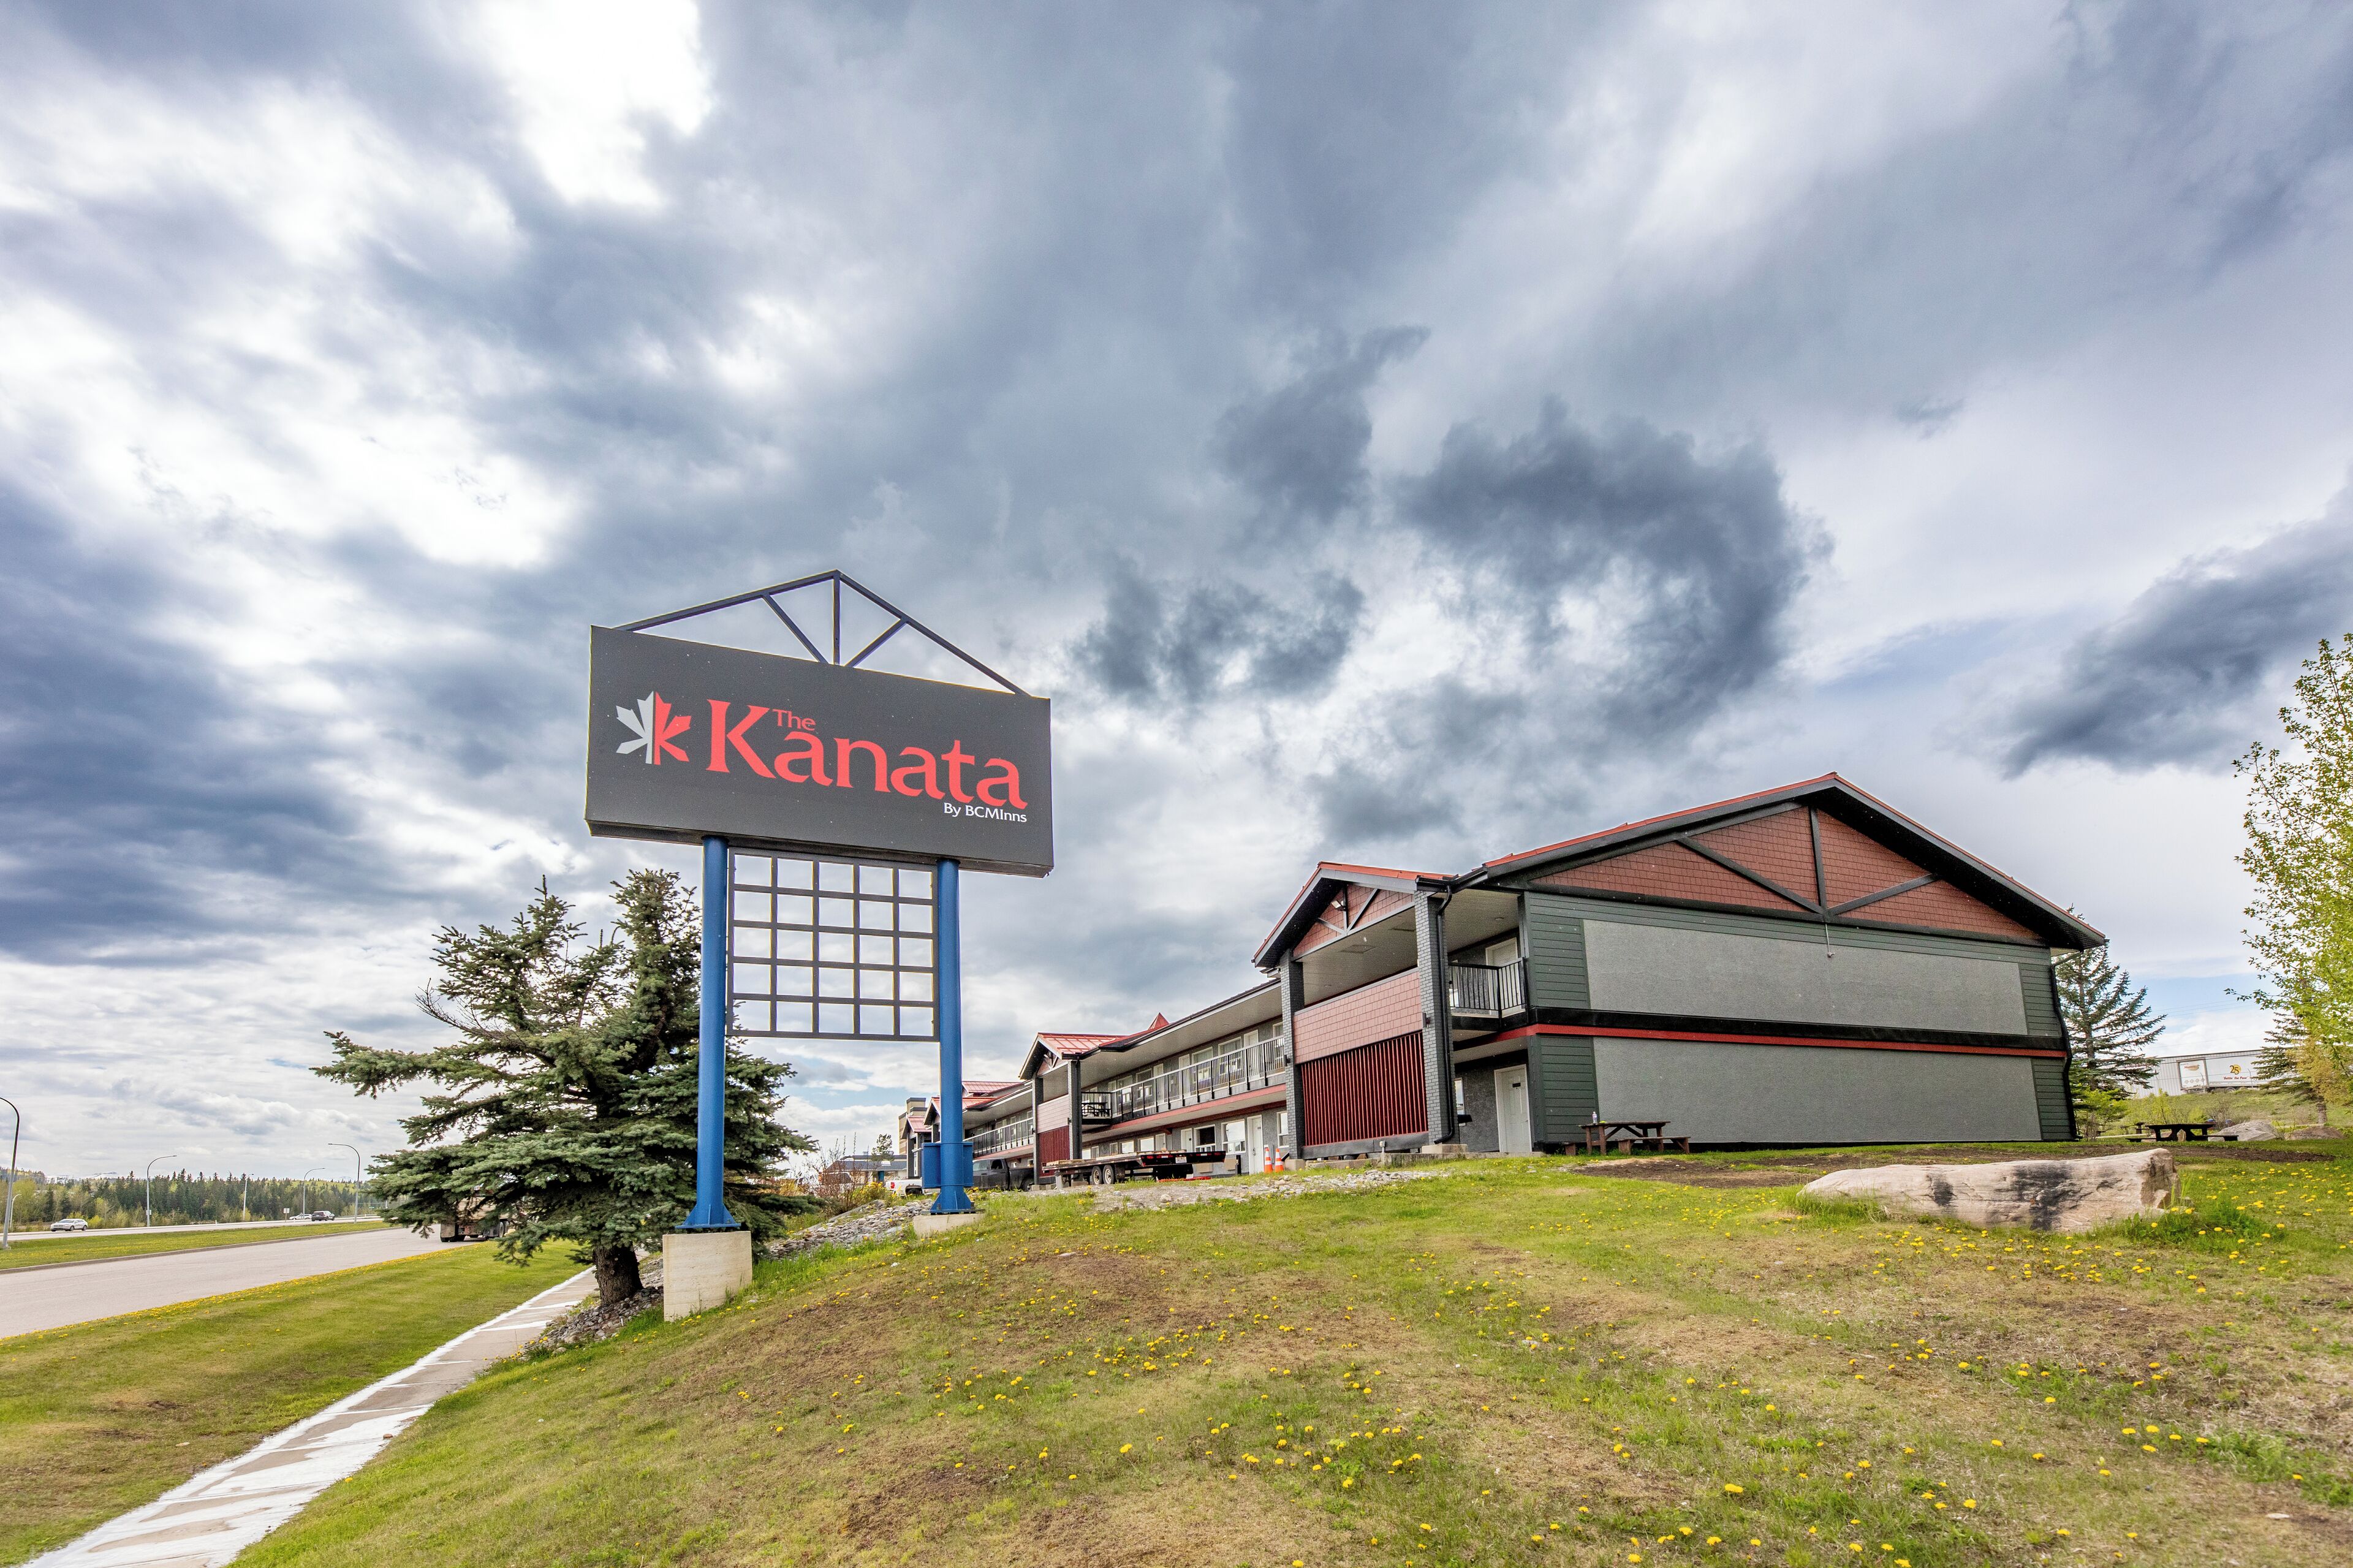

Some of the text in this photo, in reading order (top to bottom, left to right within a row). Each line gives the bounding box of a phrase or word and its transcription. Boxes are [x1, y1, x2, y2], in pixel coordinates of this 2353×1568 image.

[772, 708, 816, 731] The
[707, 699, 1028, 809] Kanata
[944, 802, 1028, 822] By BCMInns
[2229, 1065, 2240, 1075] 25
